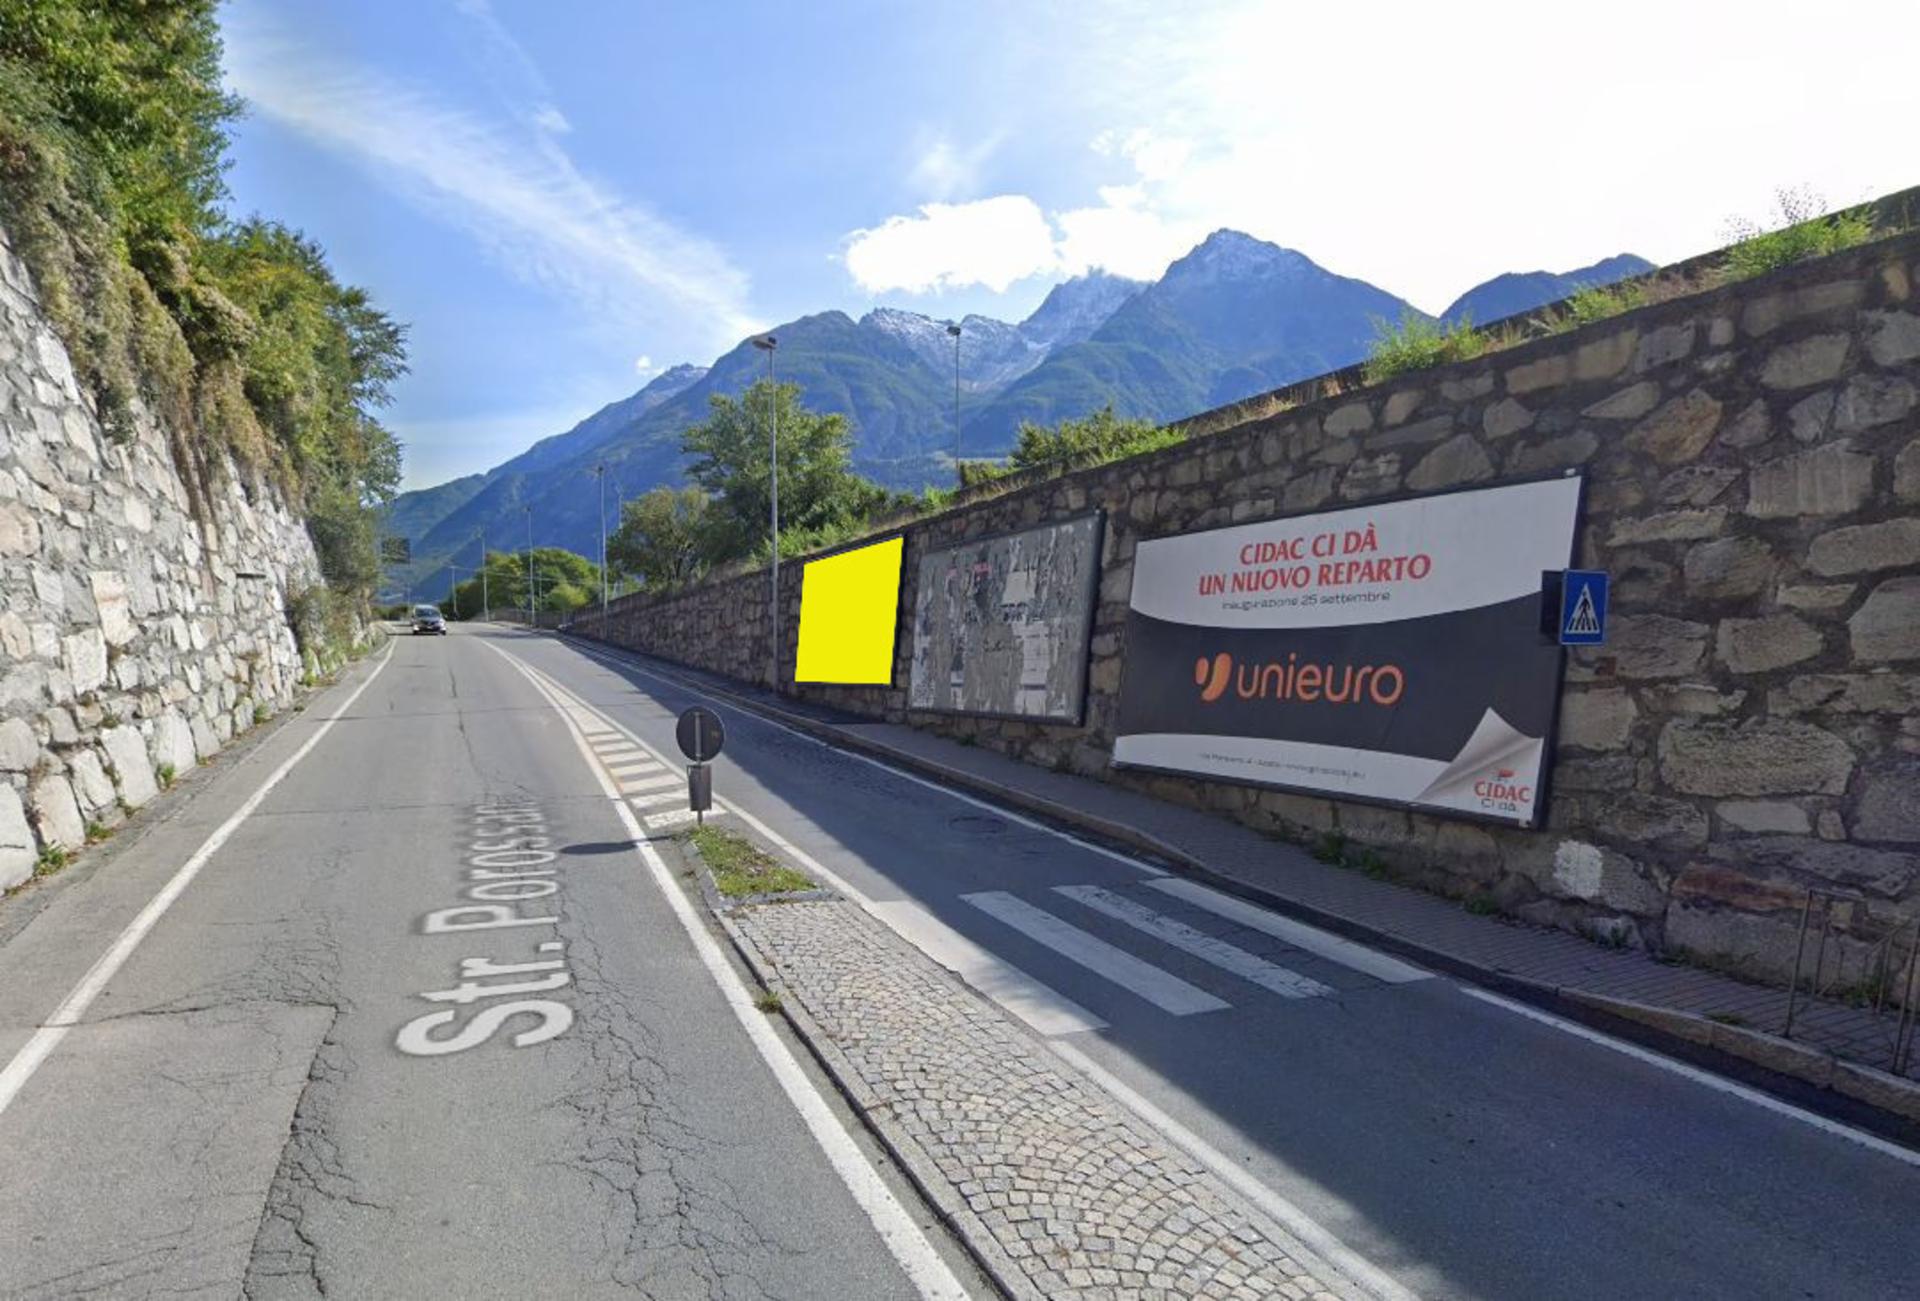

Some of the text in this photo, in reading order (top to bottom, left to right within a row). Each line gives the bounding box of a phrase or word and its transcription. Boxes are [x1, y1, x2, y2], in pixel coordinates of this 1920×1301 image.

[1240, 522, 1378, 565] CIDAC CI DÀ
[1199, 554, 1431, 596] UN NUOVO REPARTO
[1301, 593, 1318, 606] 25
[1320, 591, 1391, 604] settembre
[1237, 652, 1404, 704] unieuro
[1474, 780, 1531, 804] CIDAC
